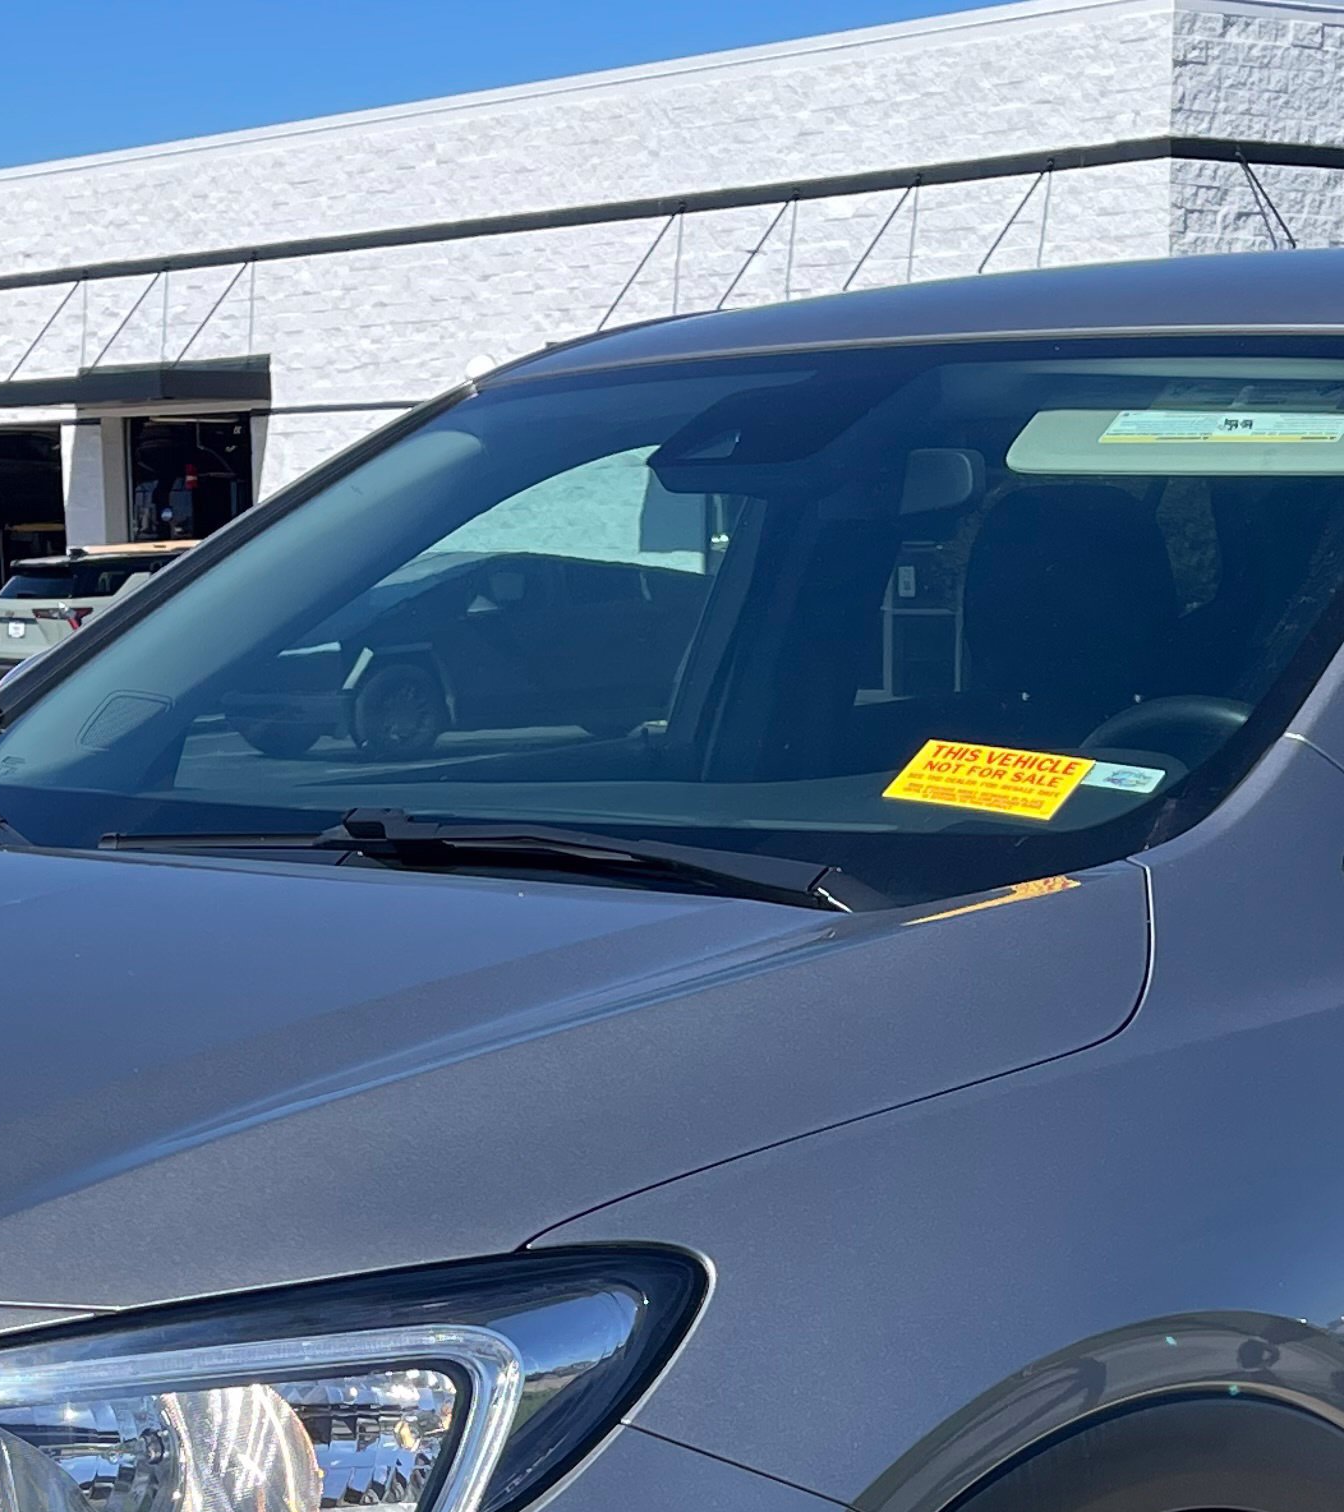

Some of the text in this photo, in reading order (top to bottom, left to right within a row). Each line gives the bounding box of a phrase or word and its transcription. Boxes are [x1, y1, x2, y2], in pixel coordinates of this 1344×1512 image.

[923, 760, 1063, 788] NOT FOR SALE
[932, 744, 1082, 775] THIS VEHICLE
